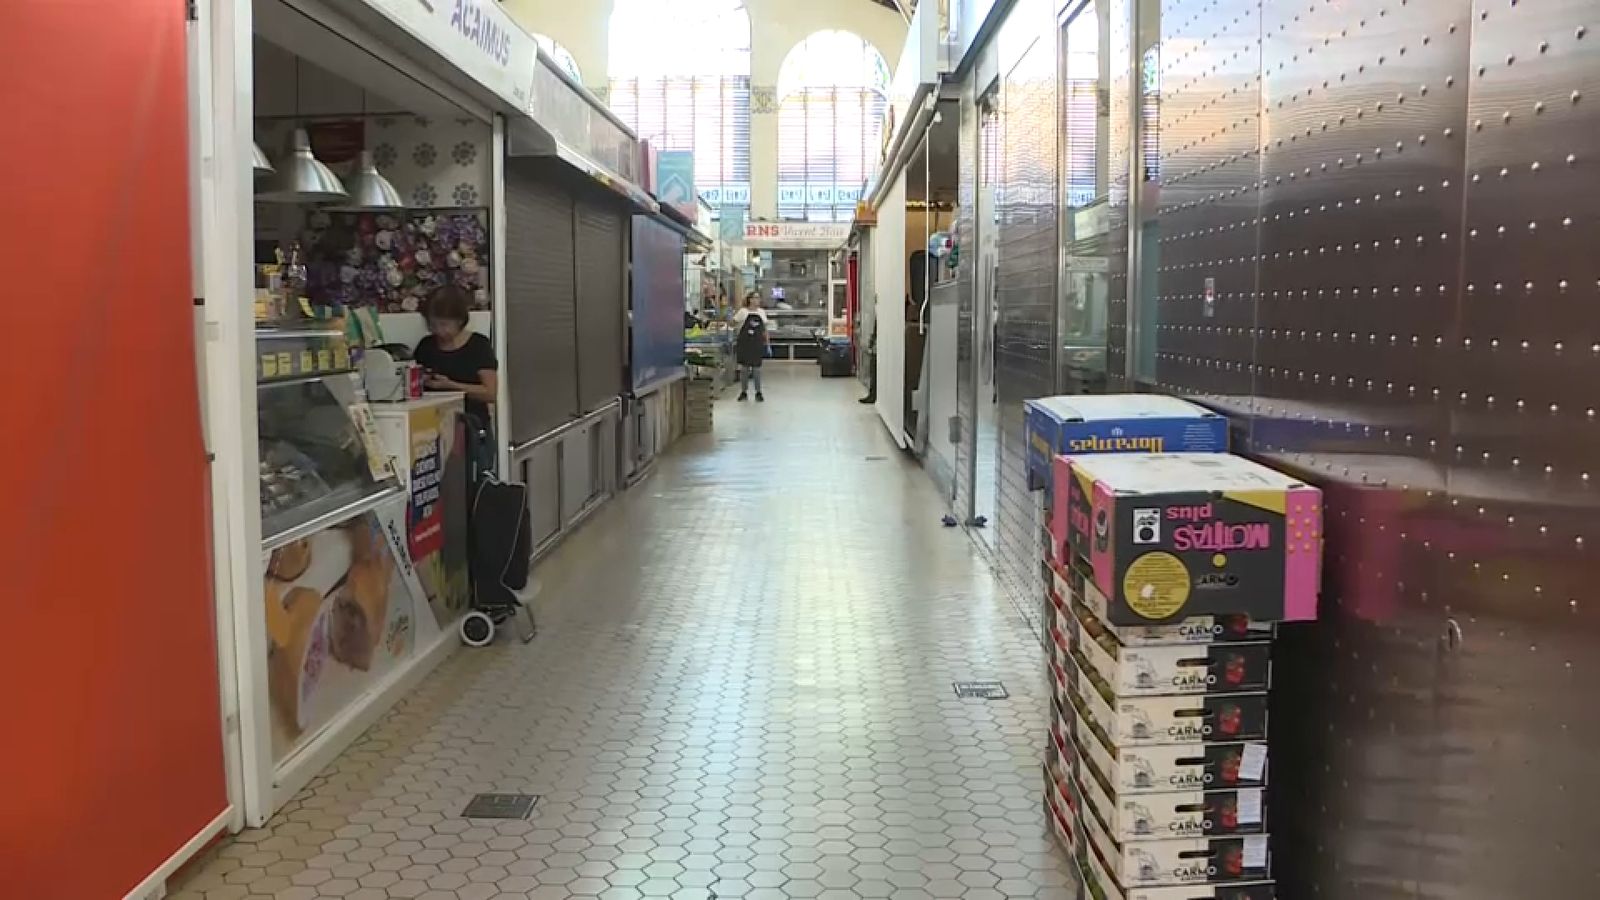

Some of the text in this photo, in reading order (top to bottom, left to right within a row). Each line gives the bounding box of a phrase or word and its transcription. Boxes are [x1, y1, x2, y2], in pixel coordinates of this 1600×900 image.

[746, 224, 780, 236] RNS
[1166, 503, 1212, 521] plus
[1179, 624, 1224, 636] CARMO
[1171, 674, 1216, 686] CARMO
[1168, 724, 1212, 736] CARMO
[1169, 772, 1214, 785] CARMO
[1168, 819, 1213, 832] CARMO
[1173, 866, 1217, 878] CARMO
